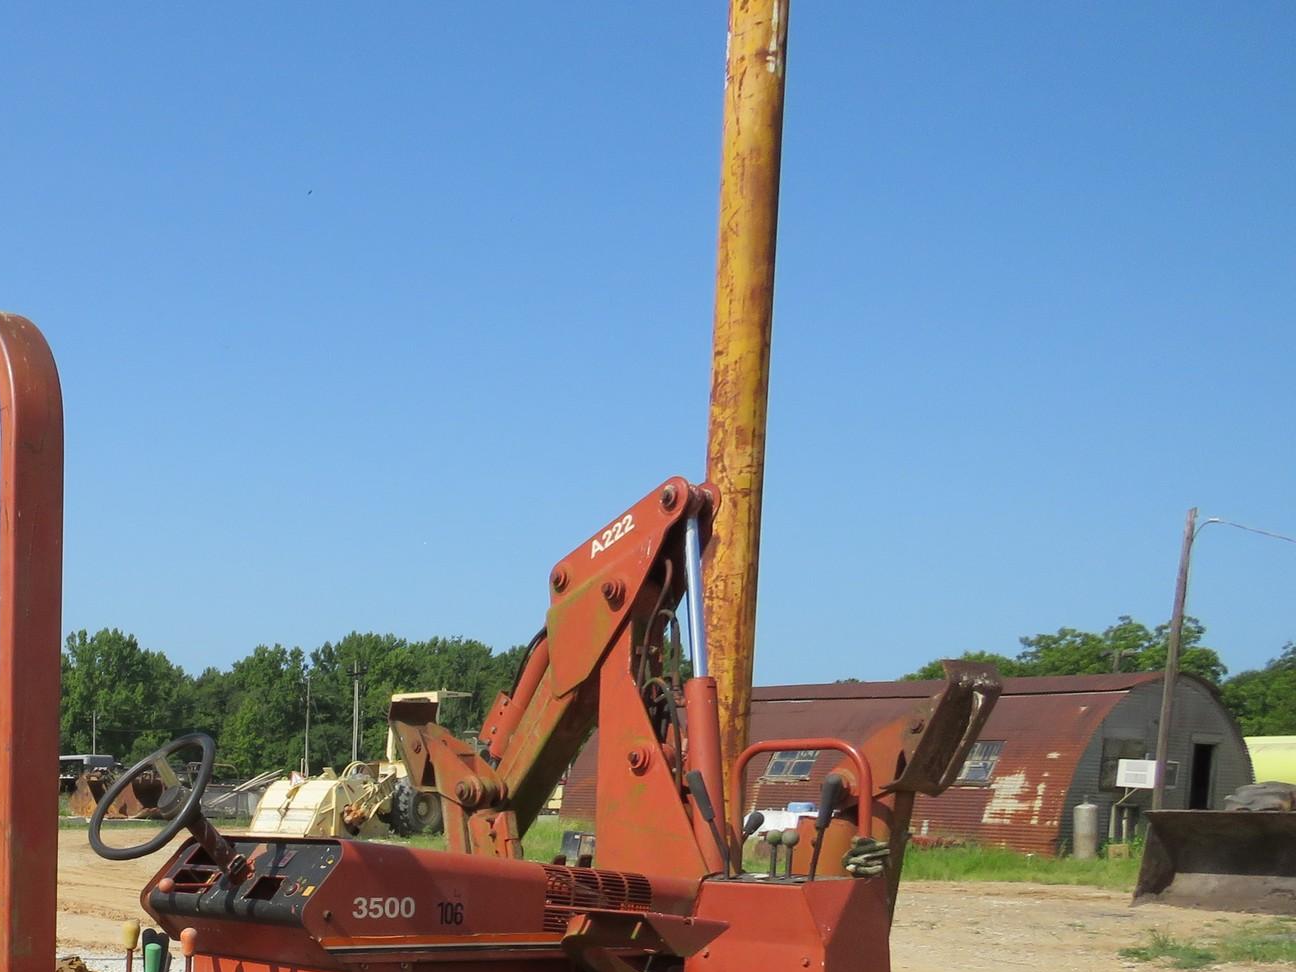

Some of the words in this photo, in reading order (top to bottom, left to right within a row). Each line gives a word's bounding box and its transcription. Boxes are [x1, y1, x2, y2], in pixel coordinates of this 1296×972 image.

[590, 514, 635, 560] A222
[352, 896, 416, 919] 3500
[437, 902, 465, 926] 106
